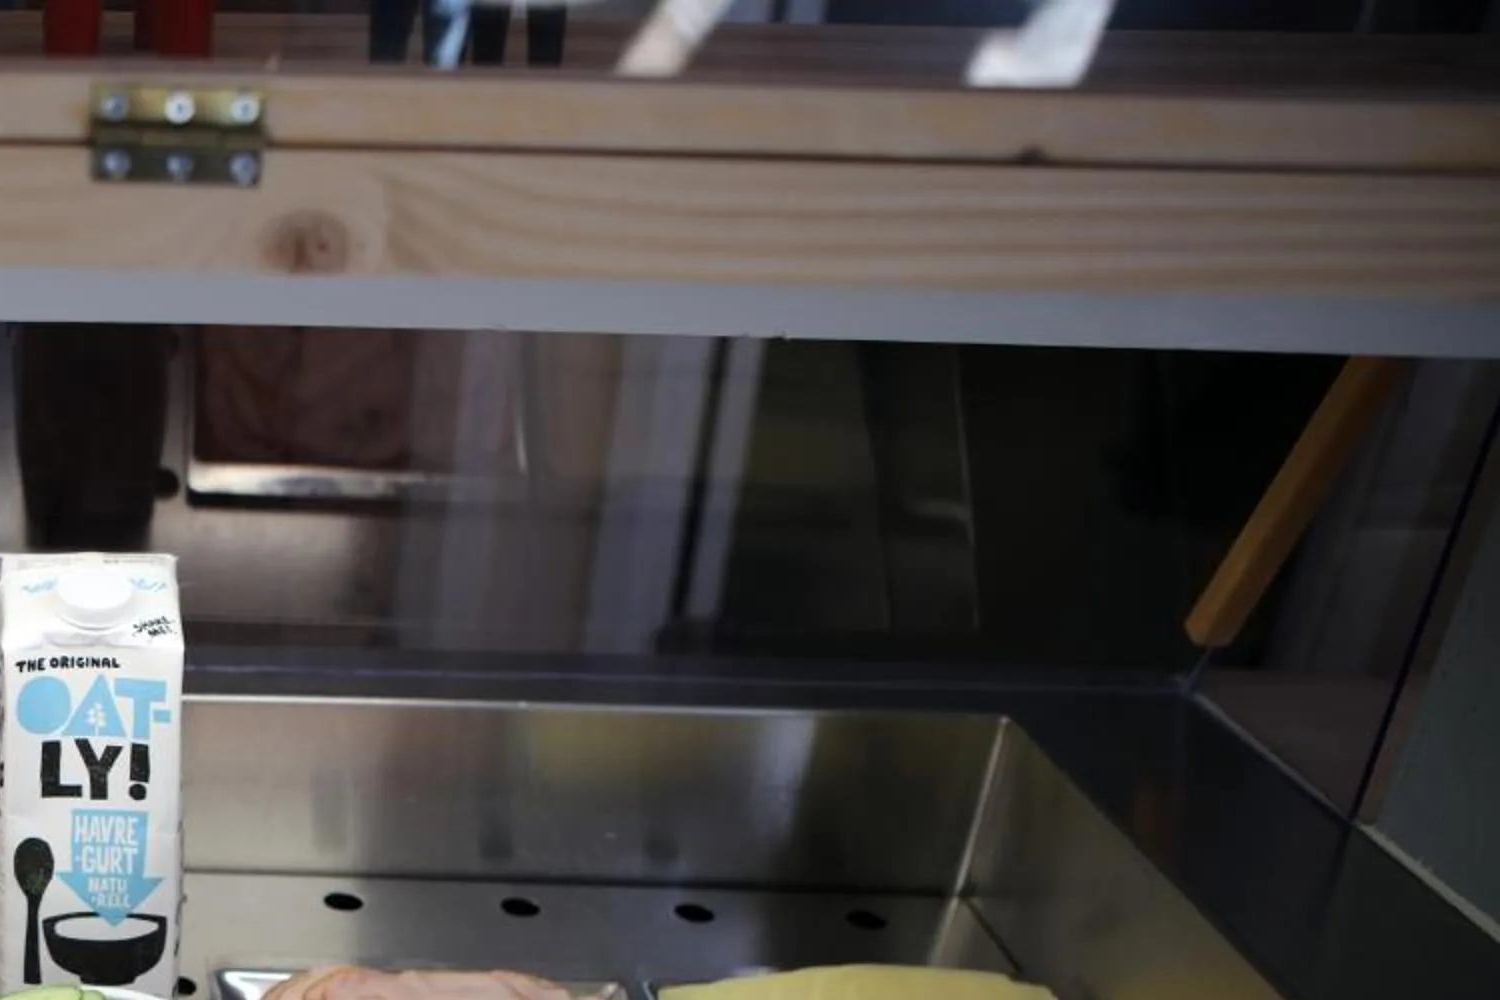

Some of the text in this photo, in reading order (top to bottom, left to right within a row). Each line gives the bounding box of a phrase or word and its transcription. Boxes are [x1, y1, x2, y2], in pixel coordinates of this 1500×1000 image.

[15, 655, 121, 674] THE ORIGINAL
[40, 738, 150, 801] LY!
[74, 814, 140, 846] HAVRE
